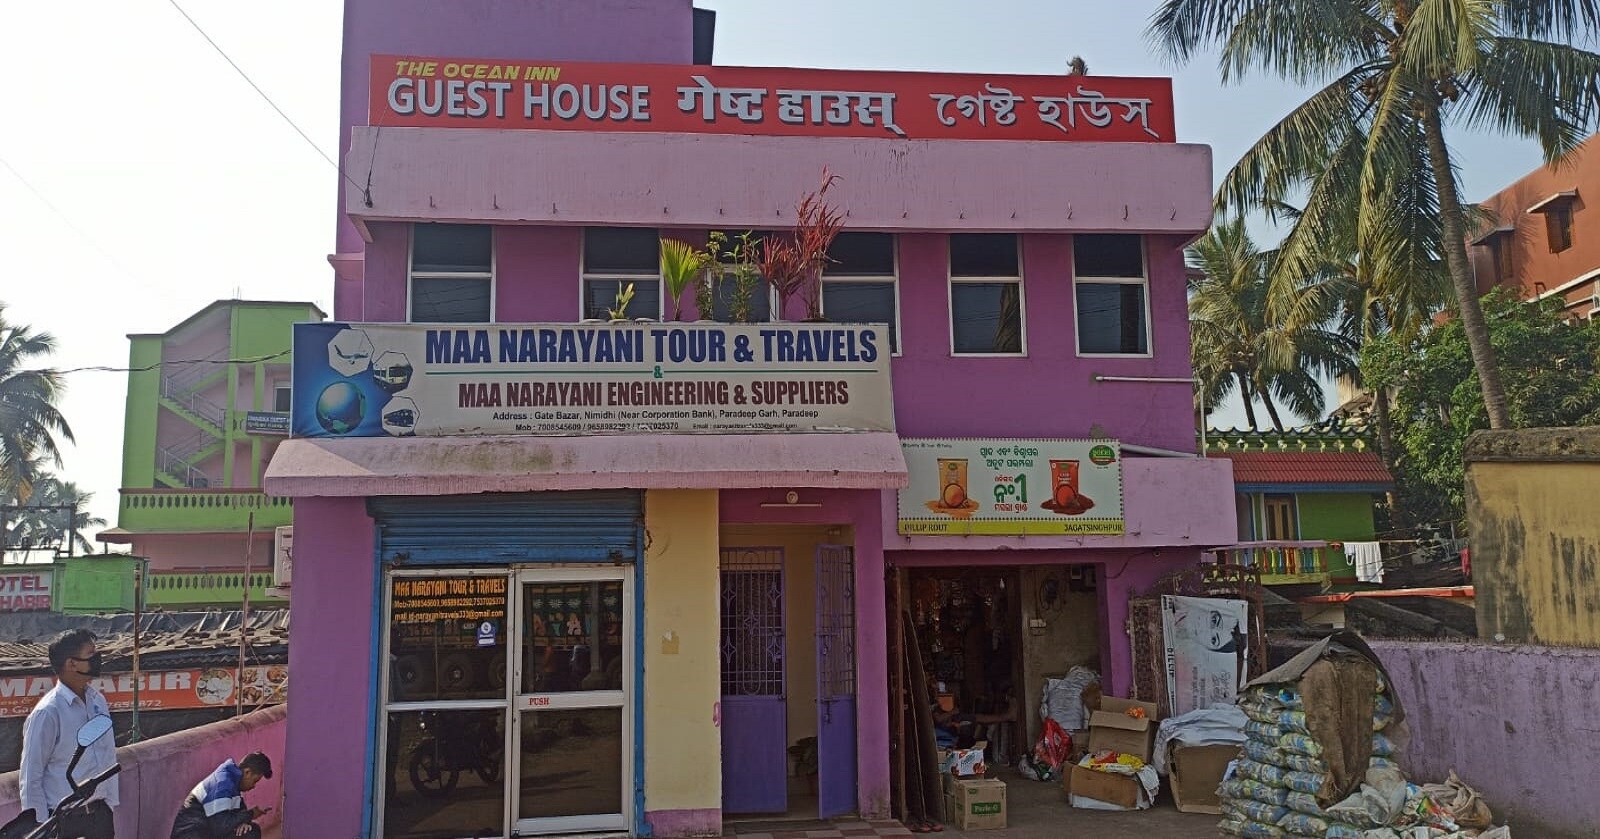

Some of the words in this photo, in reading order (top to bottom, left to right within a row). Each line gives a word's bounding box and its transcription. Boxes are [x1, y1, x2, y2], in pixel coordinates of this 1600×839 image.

[394, 60, 438, 77] THE
[443, 62, 520, 80] OCEAN
[524, 65, 561, 82] INN
[387, 76, 512, 118] GUEST
[523, 83, 650, 121] HOUSE
[676, 75, 768, 121] गेष्ट
[425, 329, 492, 364] MAA
[498, 329, 644, 363] NARAYANI
[650, 329, 726, 363] TOUR
[734, 334, 753, 363] &
[760, 329, 878, 363] TRAVELS
[653, 365, 663, 378] &
[458, 382, 501, 408] MAA
[506, 382, 602, 407] NARAYANI
[607, 380, 729, 406] ENGINEERING
[734, 384, 747, 405] &
[751, 380, 849, 405] SUPPLIERS
[492, 411, 528, 420] Address
[534, 411, 554, 420] Gate
[584, 411, 616, 420] Nimidhi
[618, 410, 640, 420] (Near
[641, 410, 690, 420] Corporation
[719, 409, 757, 420] Paradeep
[782, 409, 819, 419] Paradeep
[928, 523, 948, 532] ROUT
[449, 579, 467, 595] TOUR
[476, 578, 505, 594] TRAVELS
[529, 697, 550, 706] PUSH
